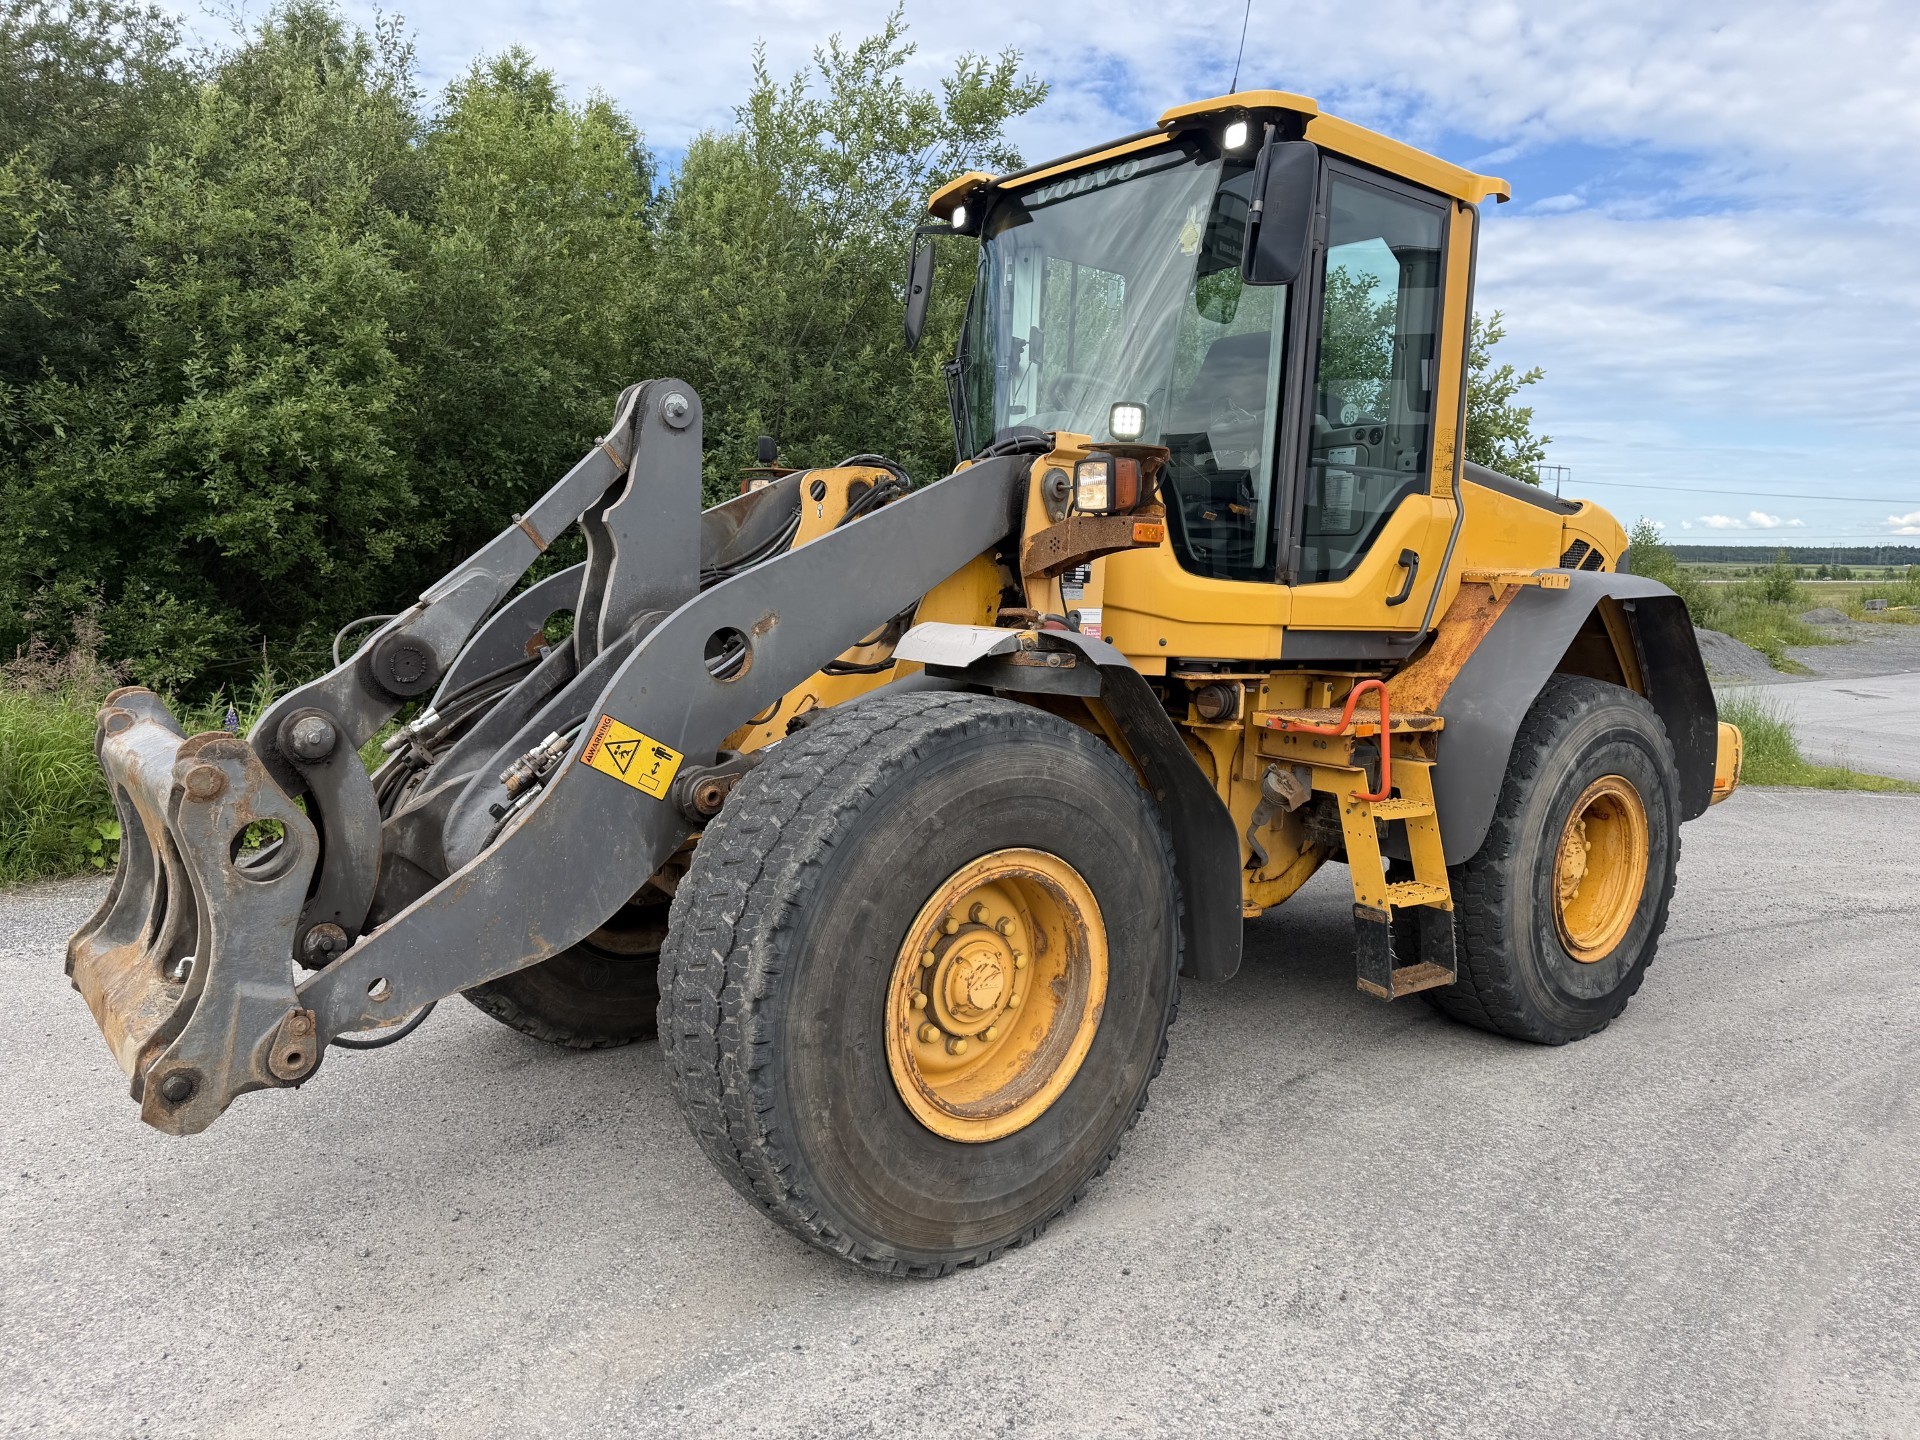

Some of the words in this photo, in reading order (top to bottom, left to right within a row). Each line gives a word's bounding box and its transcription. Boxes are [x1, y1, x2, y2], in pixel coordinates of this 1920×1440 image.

[1035, 158, 1140, 205] VOLVO
[1344, 410, 1355, 423] 68
[588, 717, 611, 756] WARNING
